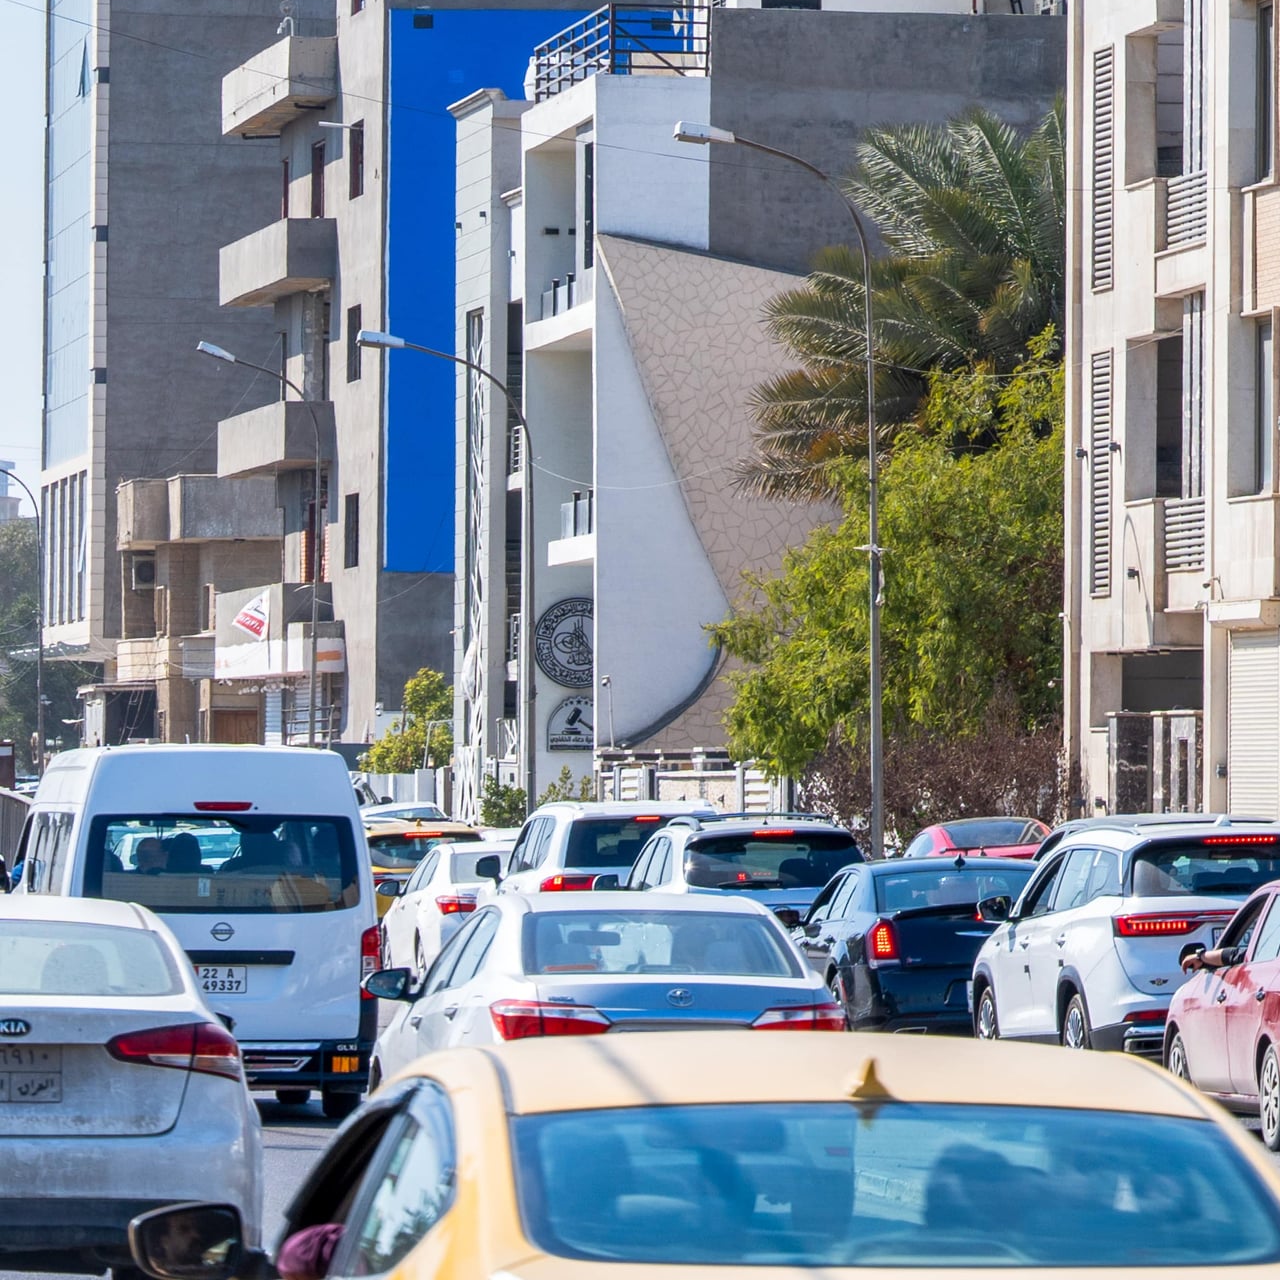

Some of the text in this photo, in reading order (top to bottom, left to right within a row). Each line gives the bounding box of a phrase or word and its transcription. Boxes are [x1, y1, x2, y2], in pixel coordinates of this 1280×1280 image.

[202, 968, 234, 979] 22 A
[202, 980, 241, 991] 49337
[0, 1021, 26, 1033] KIA
